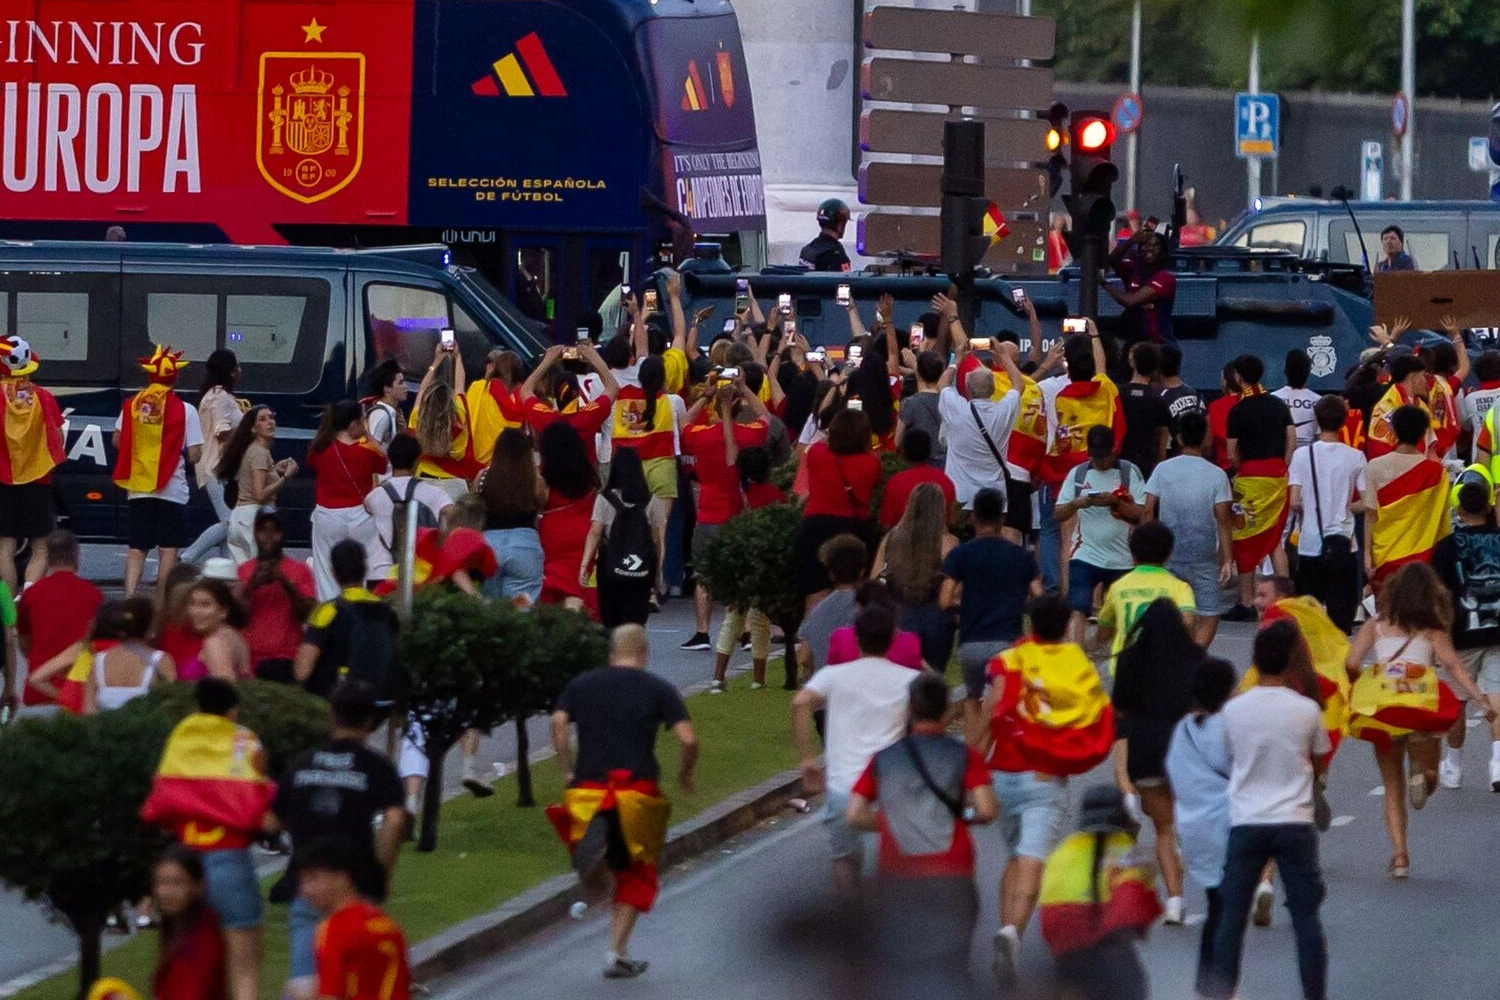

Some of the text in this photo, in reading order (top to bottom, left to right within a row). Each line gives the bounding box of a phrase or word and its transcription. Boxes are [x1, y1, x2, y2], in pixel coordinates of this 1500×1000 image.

[691, 153, 711, 171] ONLY
[710, 153, 727, 170] THE
[427, 176, 607, 189] SELECCIÓN ESPAÑOLA
[475, 189, 564, 202] DE FÚTBOL
